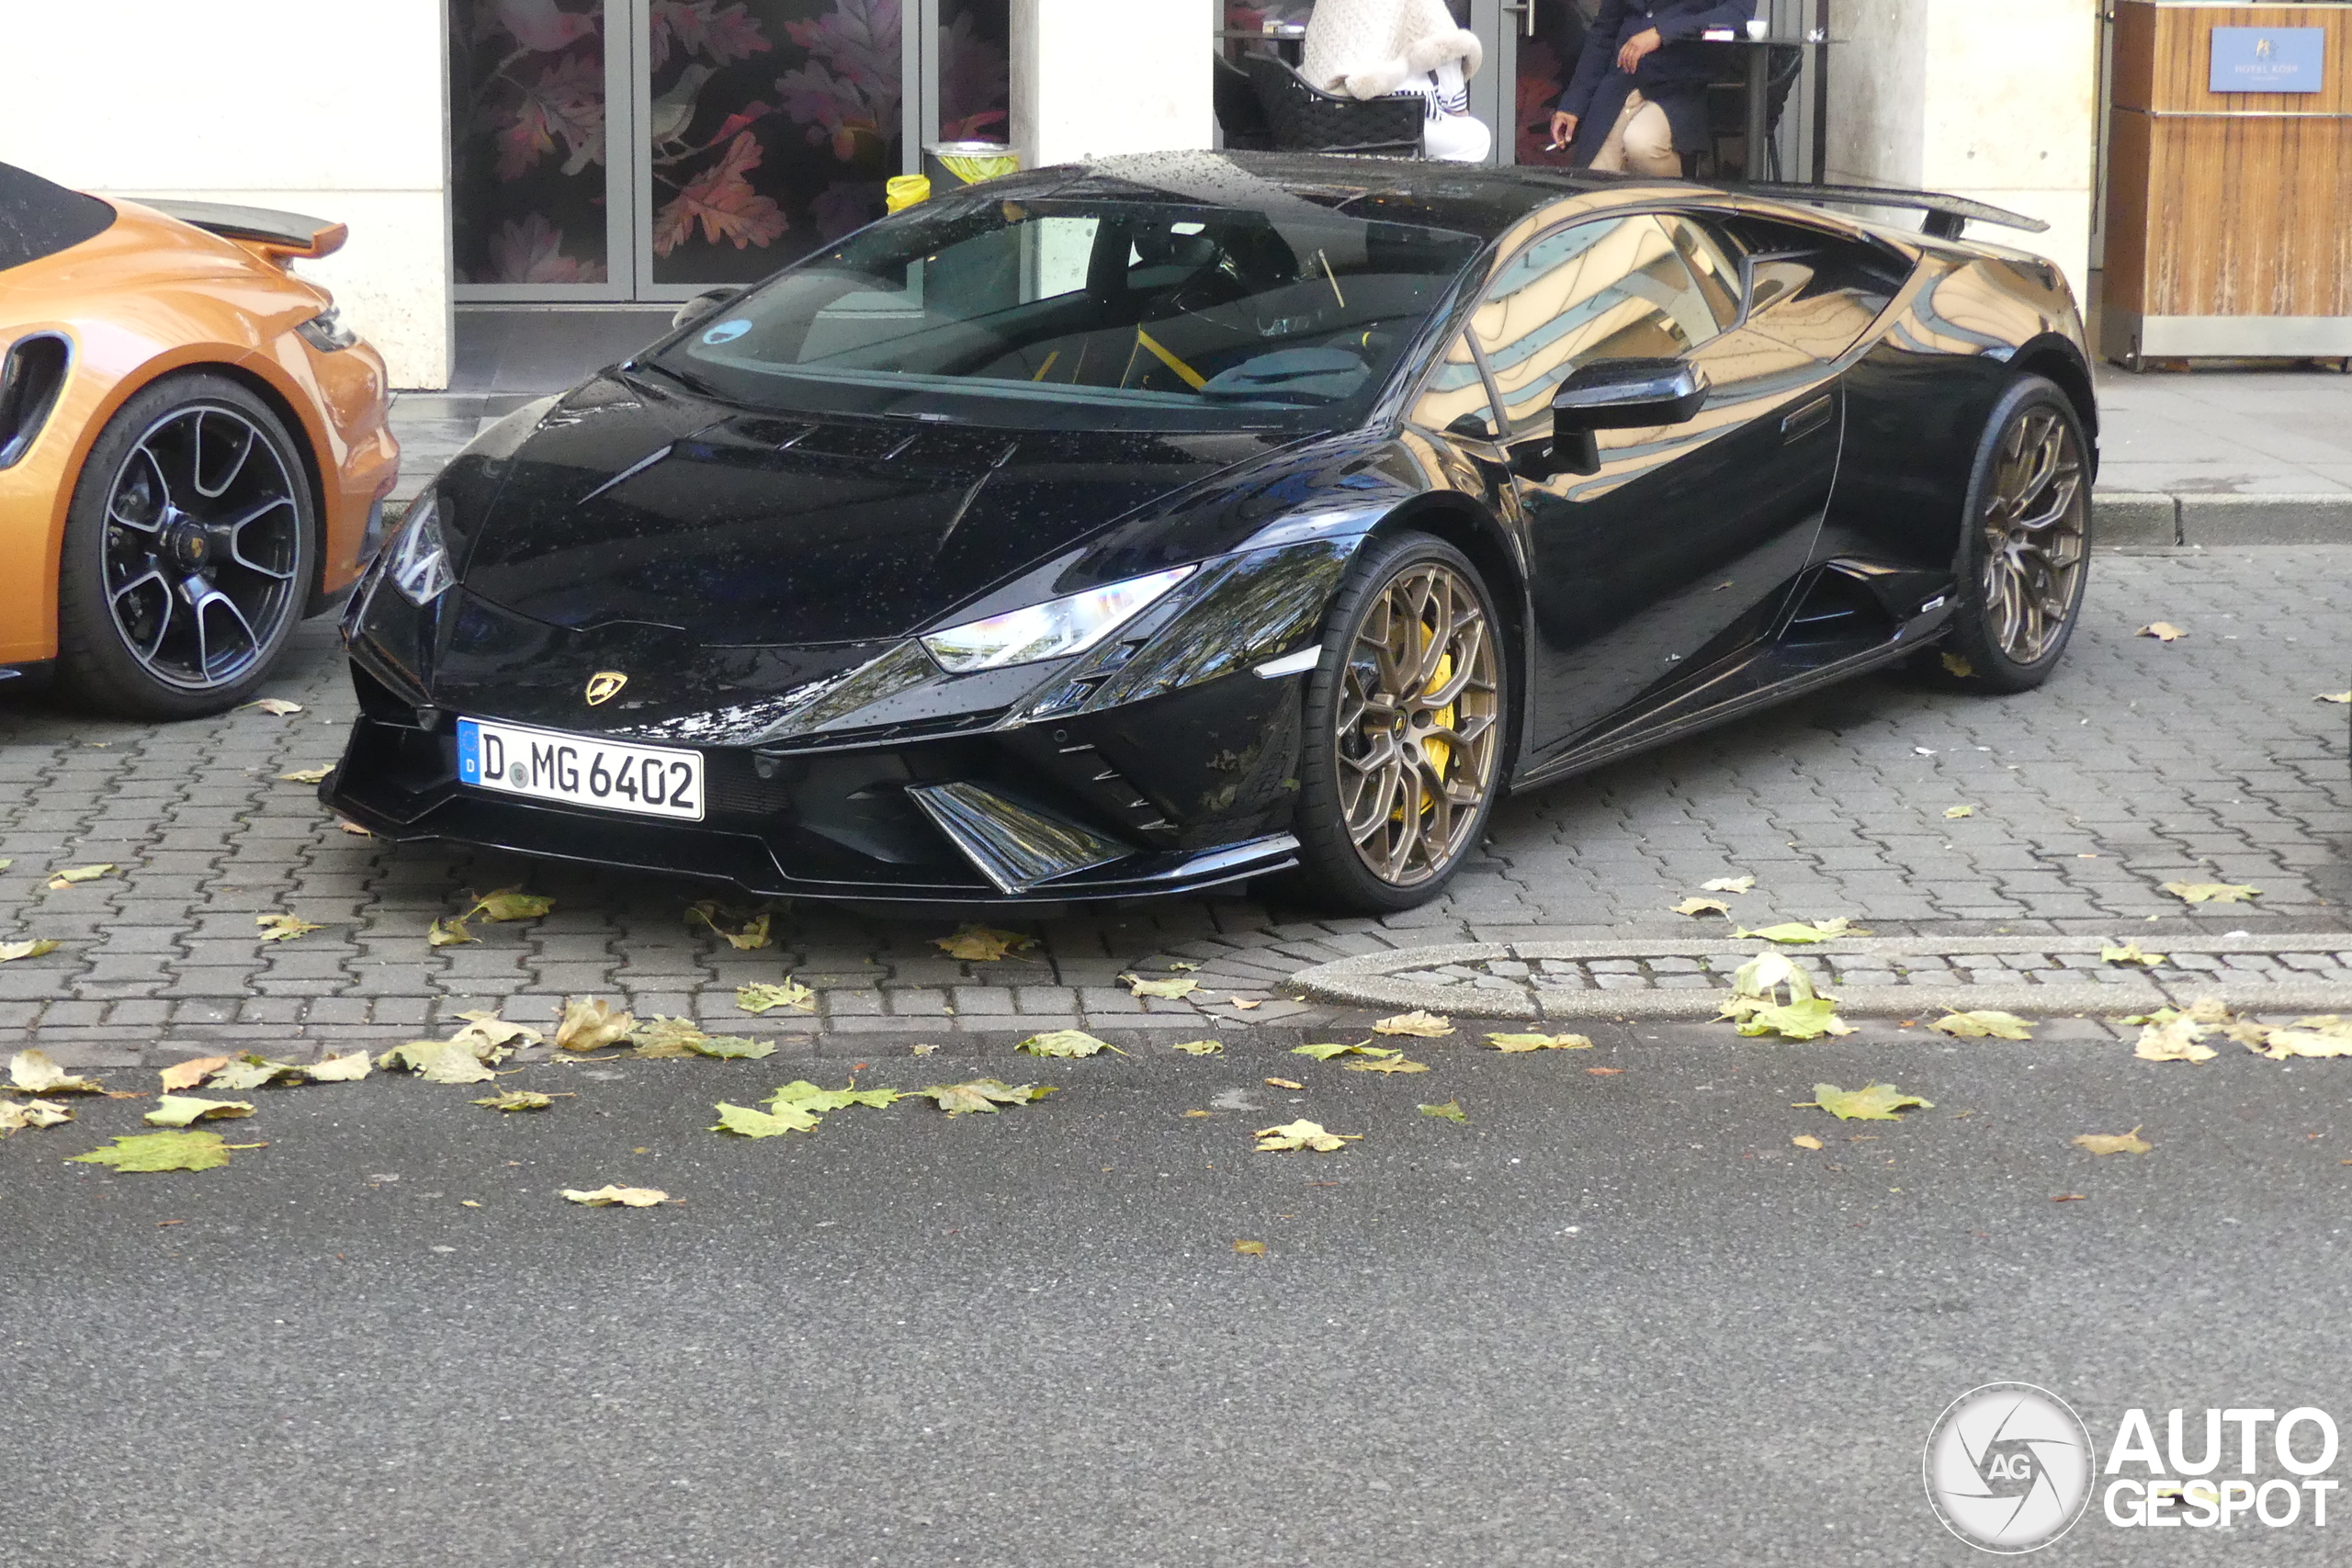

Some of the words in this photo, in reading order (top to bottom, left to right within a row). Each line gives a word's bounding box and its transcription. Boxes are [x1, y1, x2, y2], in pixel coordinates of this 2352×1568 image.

[2234, 65, 2268, 73] HOTEL
[466, 759, 475, 773] D
[483, 733, 504, 780] D
[531, 741, 579, 794] MG
[589, 751, 695, 809] 6402
